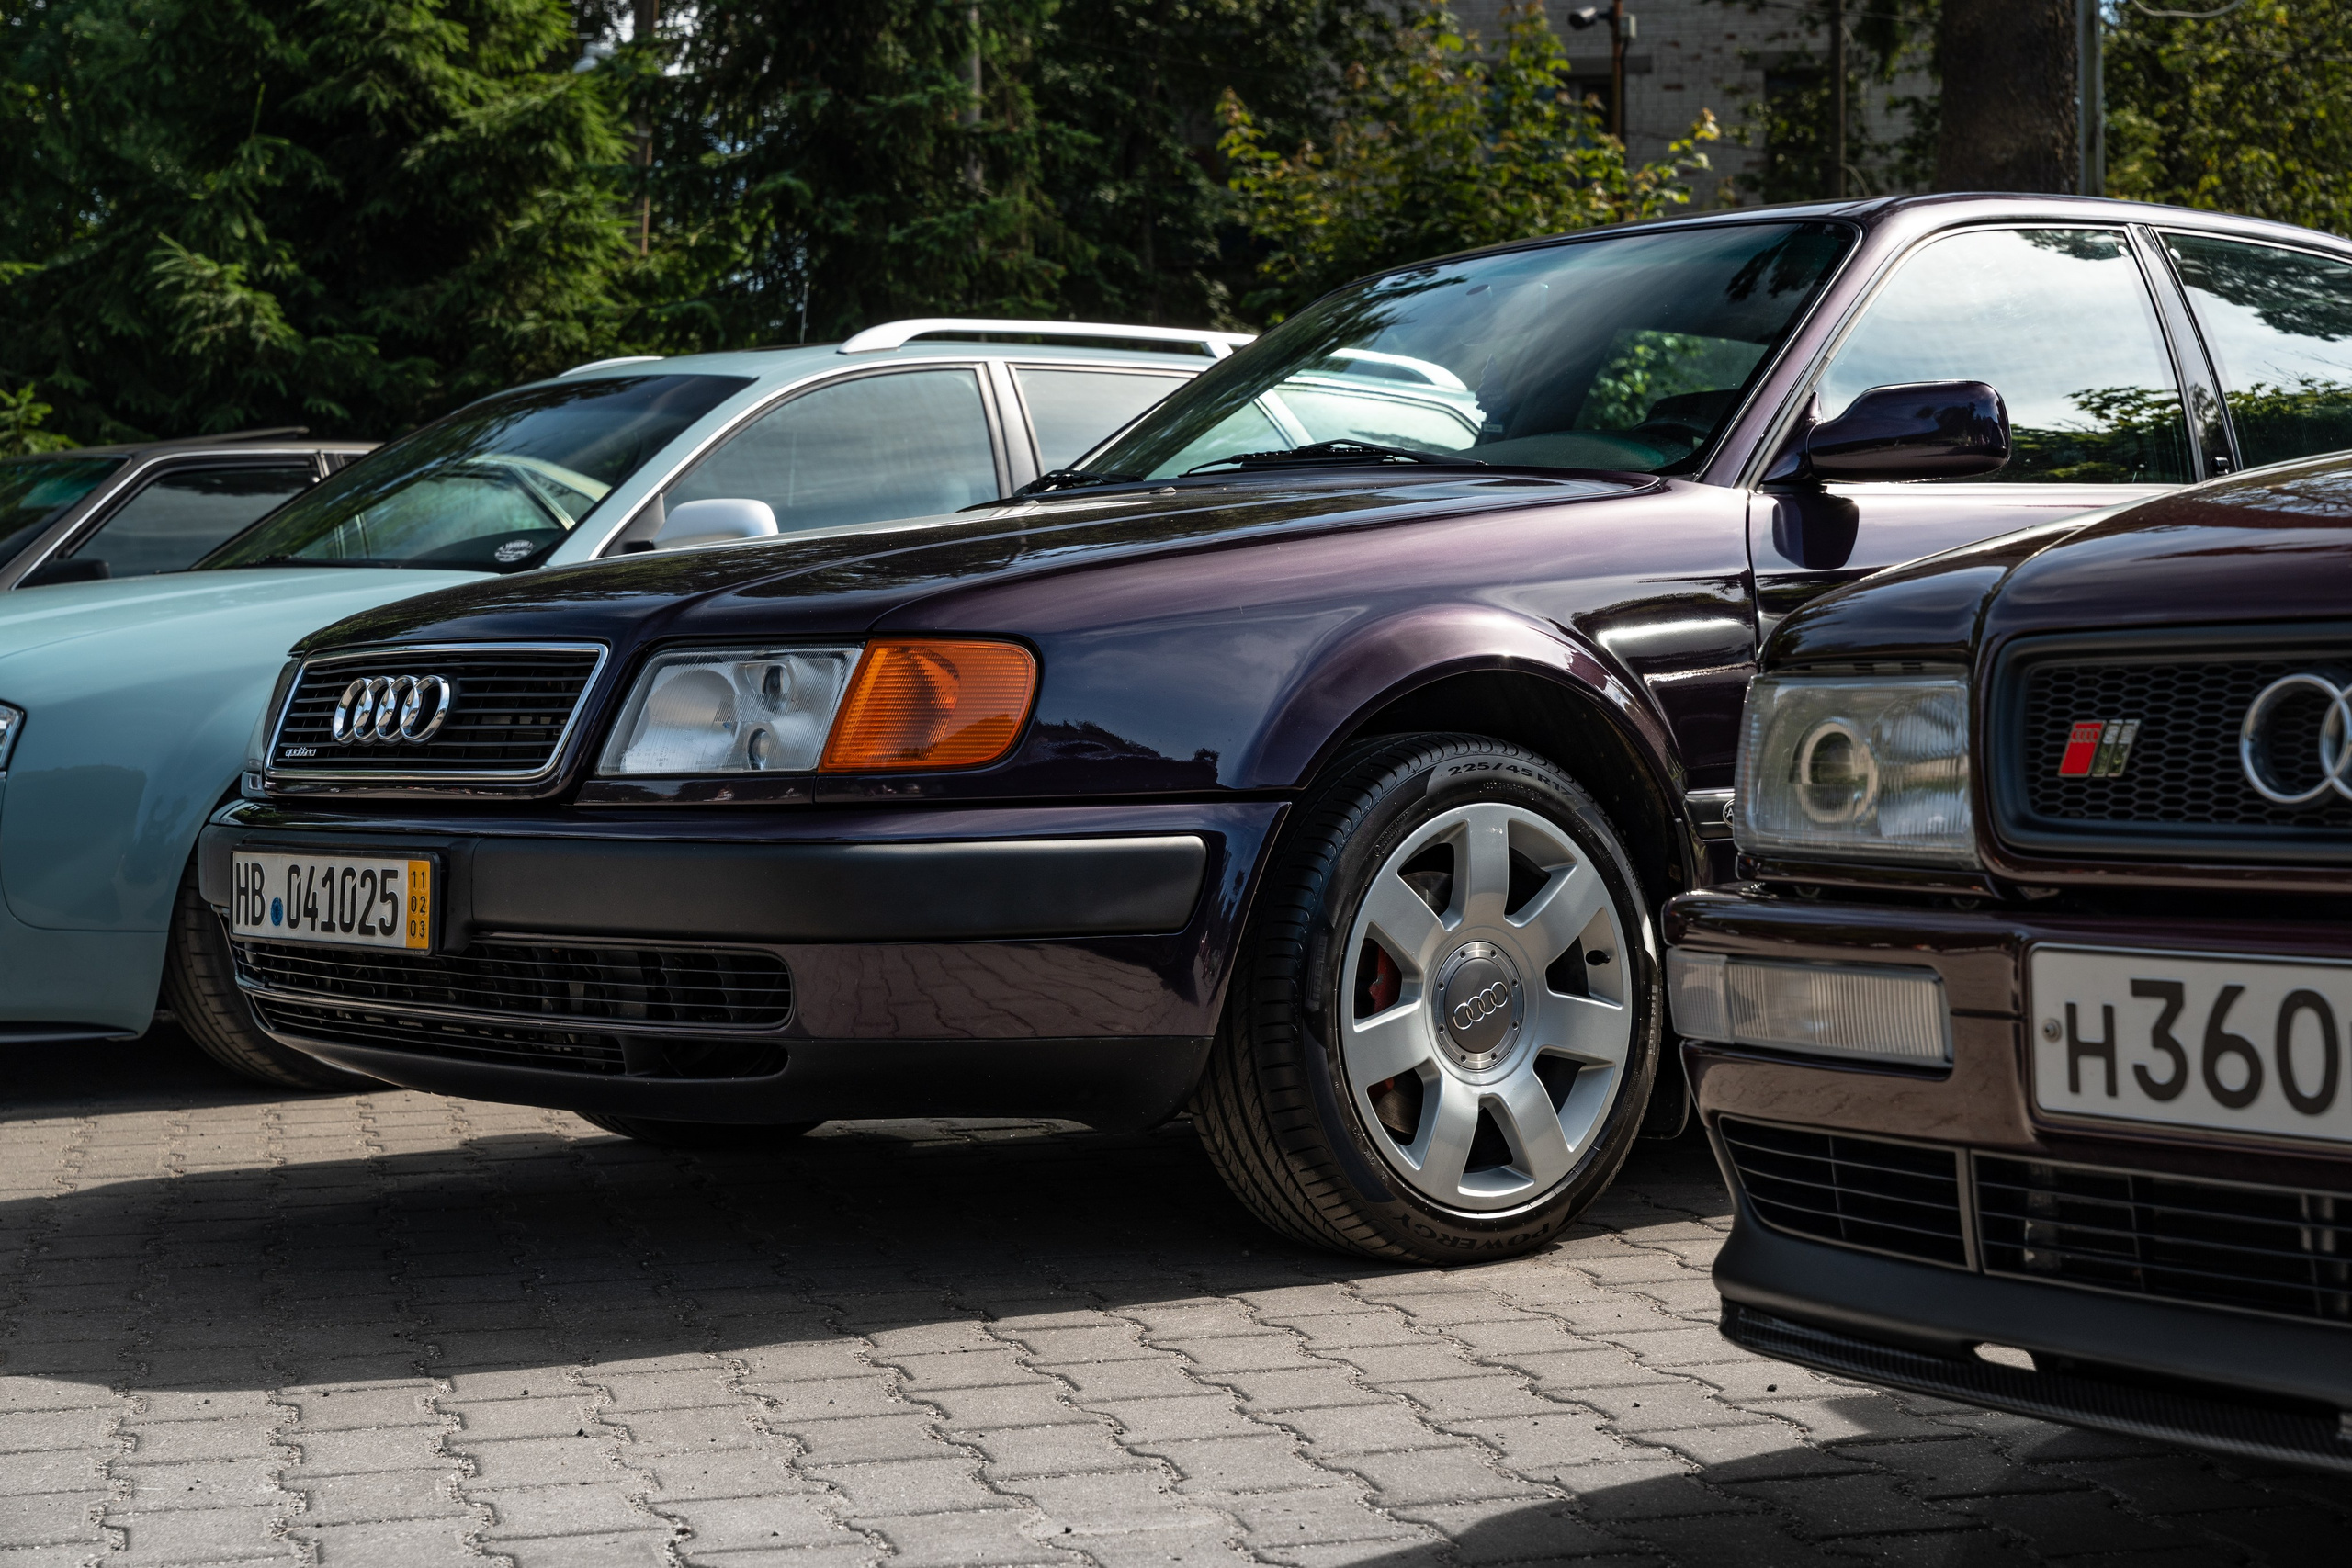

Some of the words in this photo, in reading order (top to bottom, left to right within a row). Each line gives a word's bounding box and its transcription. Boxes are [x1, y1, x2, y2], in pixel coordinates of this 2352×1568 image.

[285, 747, 317, 759] quattro
[1448, 761, 1532, 777] 225/45
[1538, 773, 1573, 796] R17
[412, 871, 426, 890] 11
[236, 863, 265, 926] HB
[287, 864, 399, 936] 041025
[411, 896, 426, 914] 02
[410, 919, 425, 938] 03
[2064, 977, 2352, 1117] H360
[1393, 1213, 1550, 1251] POWERGY
